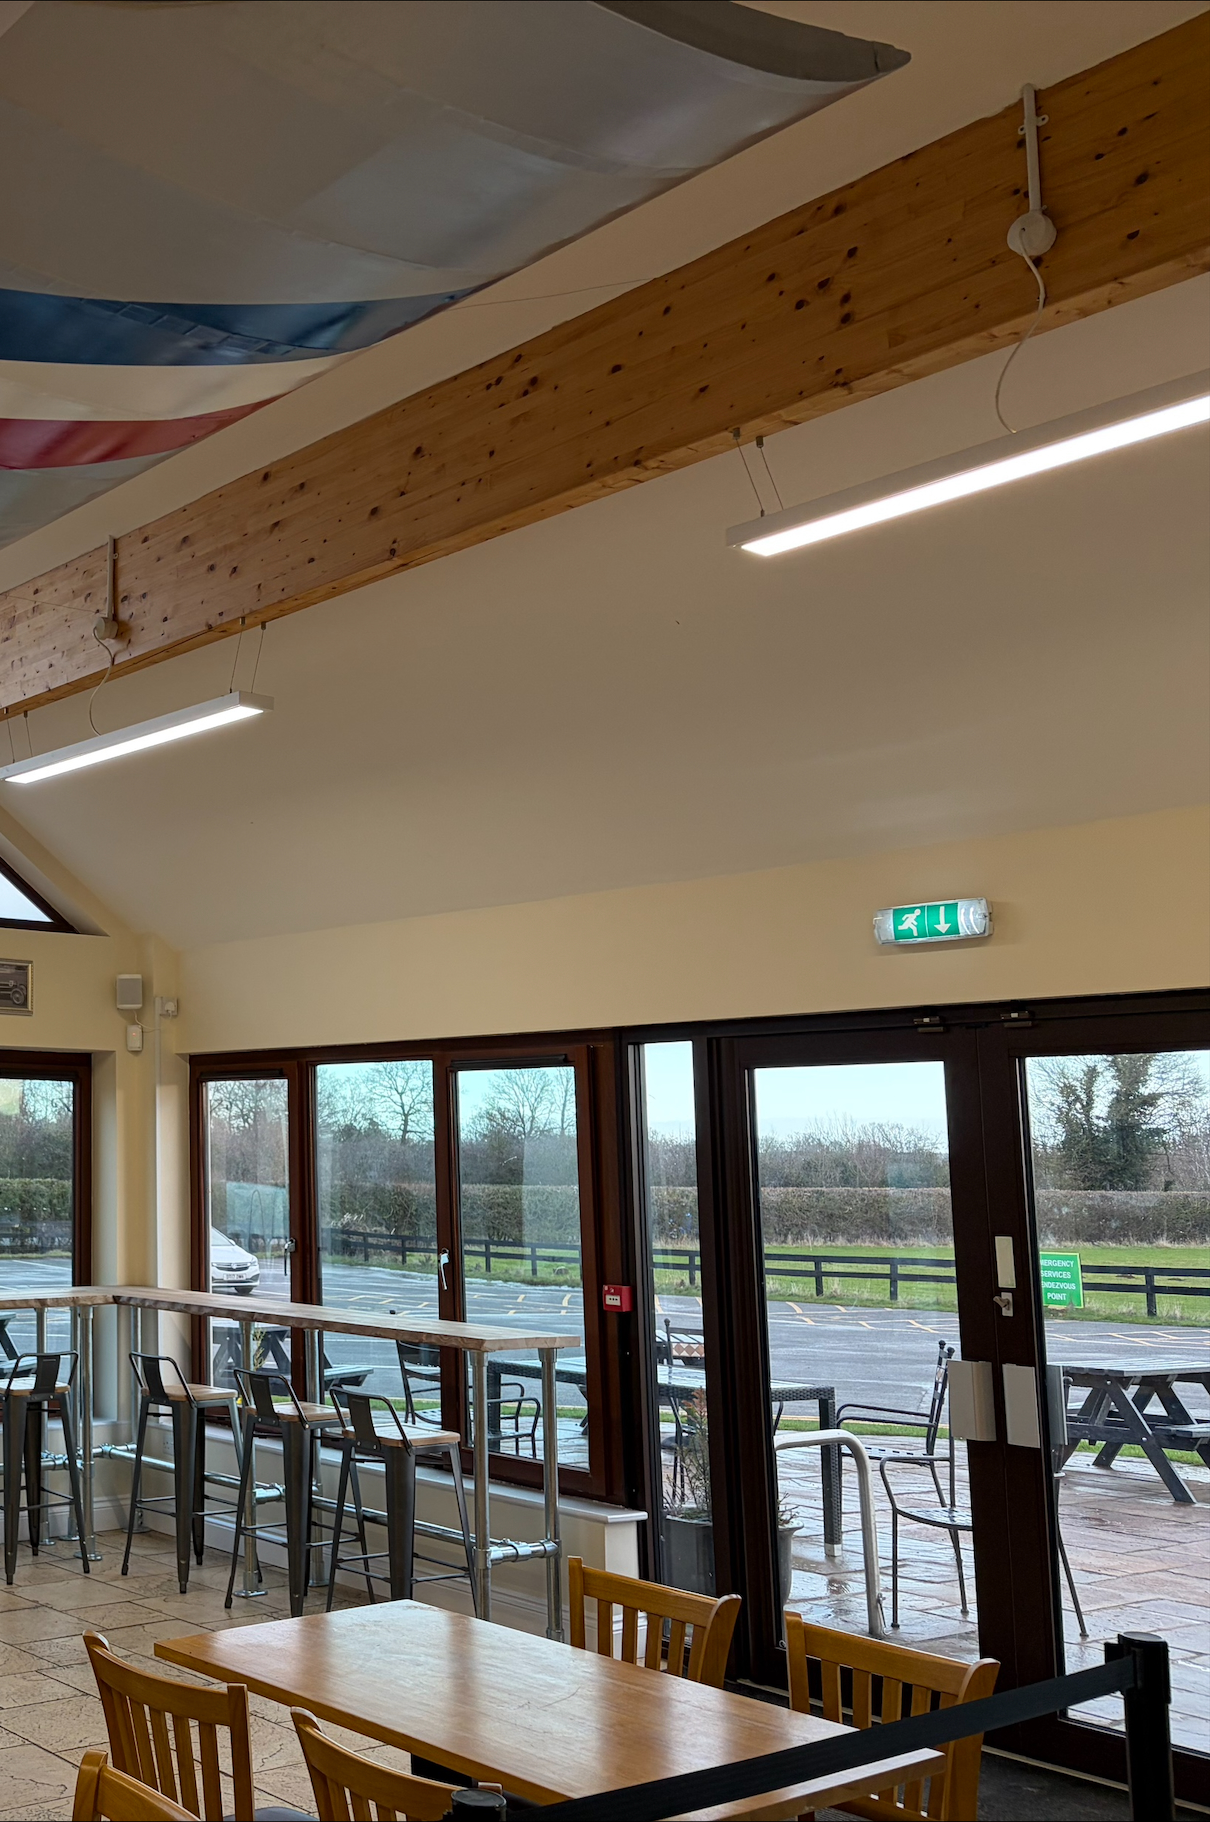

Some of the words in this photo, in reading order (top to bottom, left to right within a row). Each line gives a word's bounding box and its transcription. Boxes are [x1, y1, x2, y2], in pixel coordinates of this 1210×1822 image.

[1040, 1259, 1074, 1267] MERGENCY
[1041, 1270, 1071, 1279] SERVICES
[1041, 1281, 1076, 1290] ENDEZVOUS
[1047, 1292, 1067, 1300] POINT
